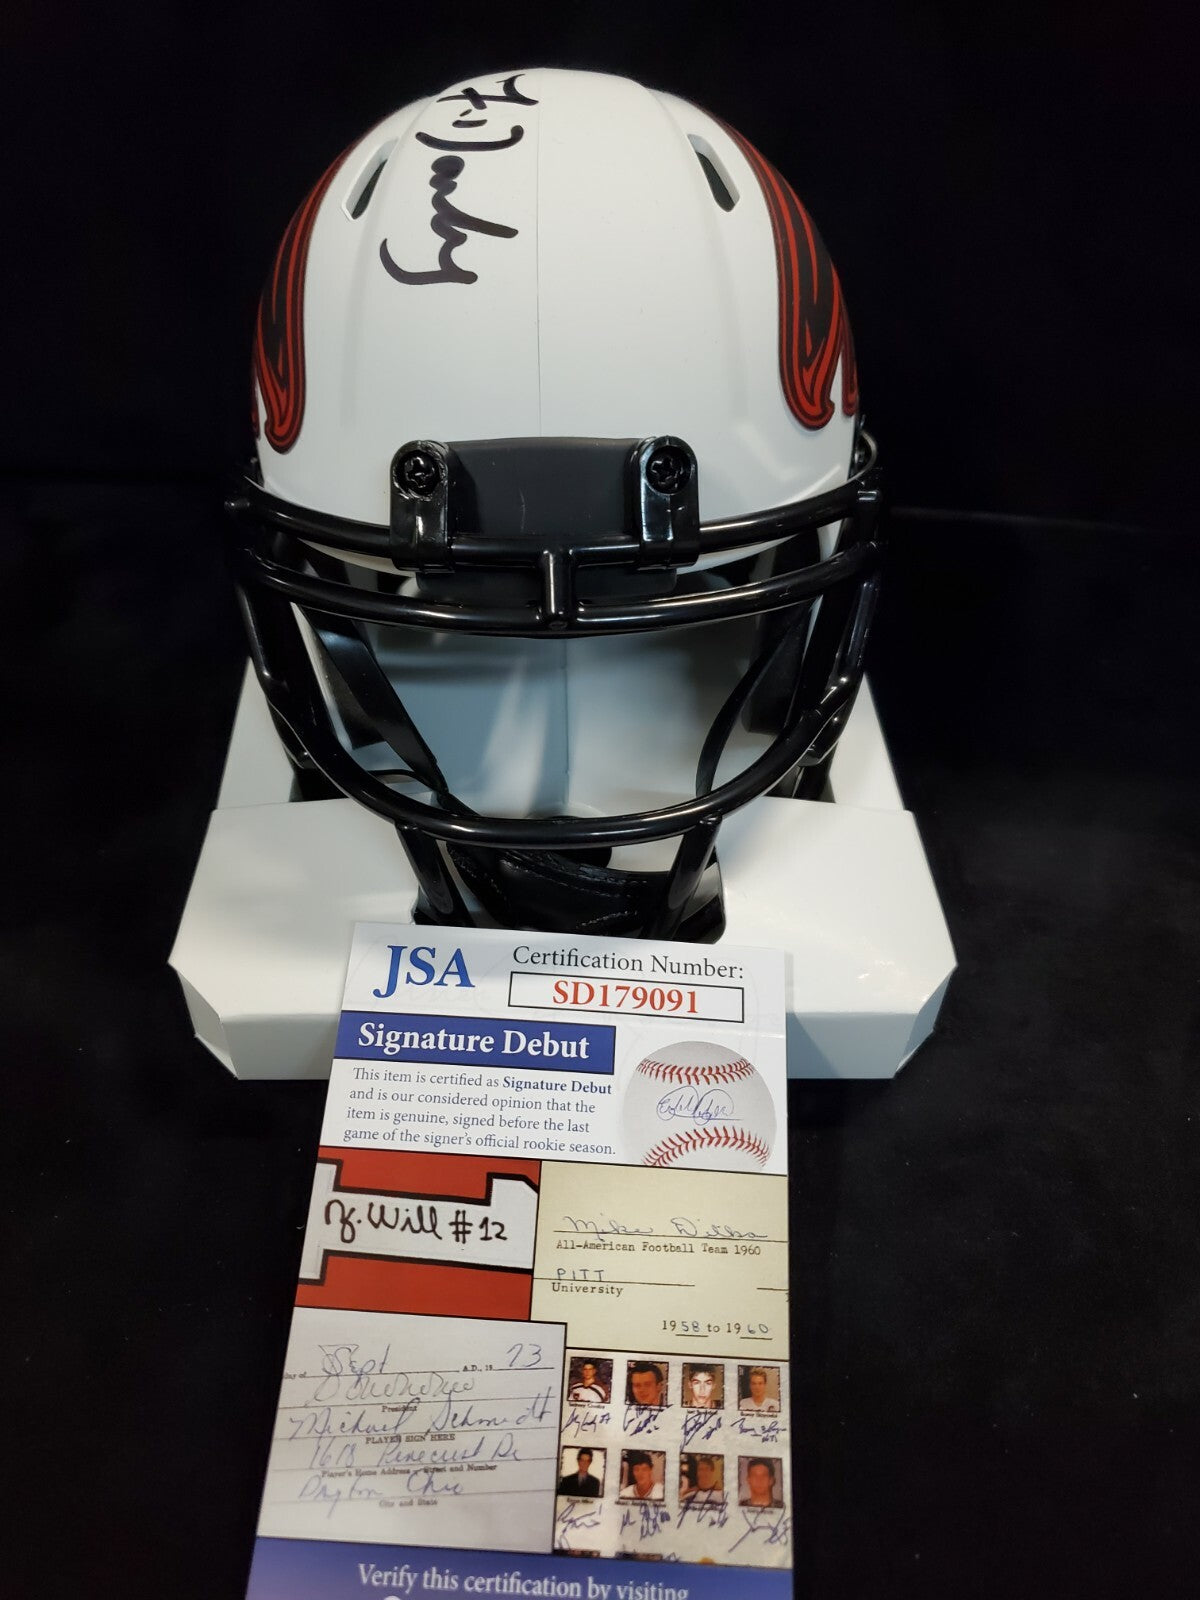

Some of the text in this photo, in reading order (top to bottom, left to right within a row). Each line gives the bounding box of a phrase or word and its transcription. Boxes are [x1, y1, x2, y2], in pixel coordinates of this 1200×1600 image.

[373, 945, 475, 999] JSA
[513, 945, 743, 979] Certification Number:
[552, 980, 699, 1014] SD179091
[358, 1022, 590, 1059] Signature Debut
[353, 1067, 612, 1094] This item is certified as Signature Debut
[349, 1087, 596, 1113] and is our considered opinion that the
[347, 1106, 590, 1133] item is genuine, signed before the last
[343, 1128, 616, 1155] game of the signer's official rookie season.
[556, 1240, 761, 1256] All-American Football Team 1960
[557, 1267, 605, 1281] PITT
[552, 1281, 624, 1297] University
[707, 1321, 720, 1333] to
[365, 1433, 455, 1444] PLAYER SIGN HERE
[358, 1563, 689, 1600] Verify this certification by visiting
